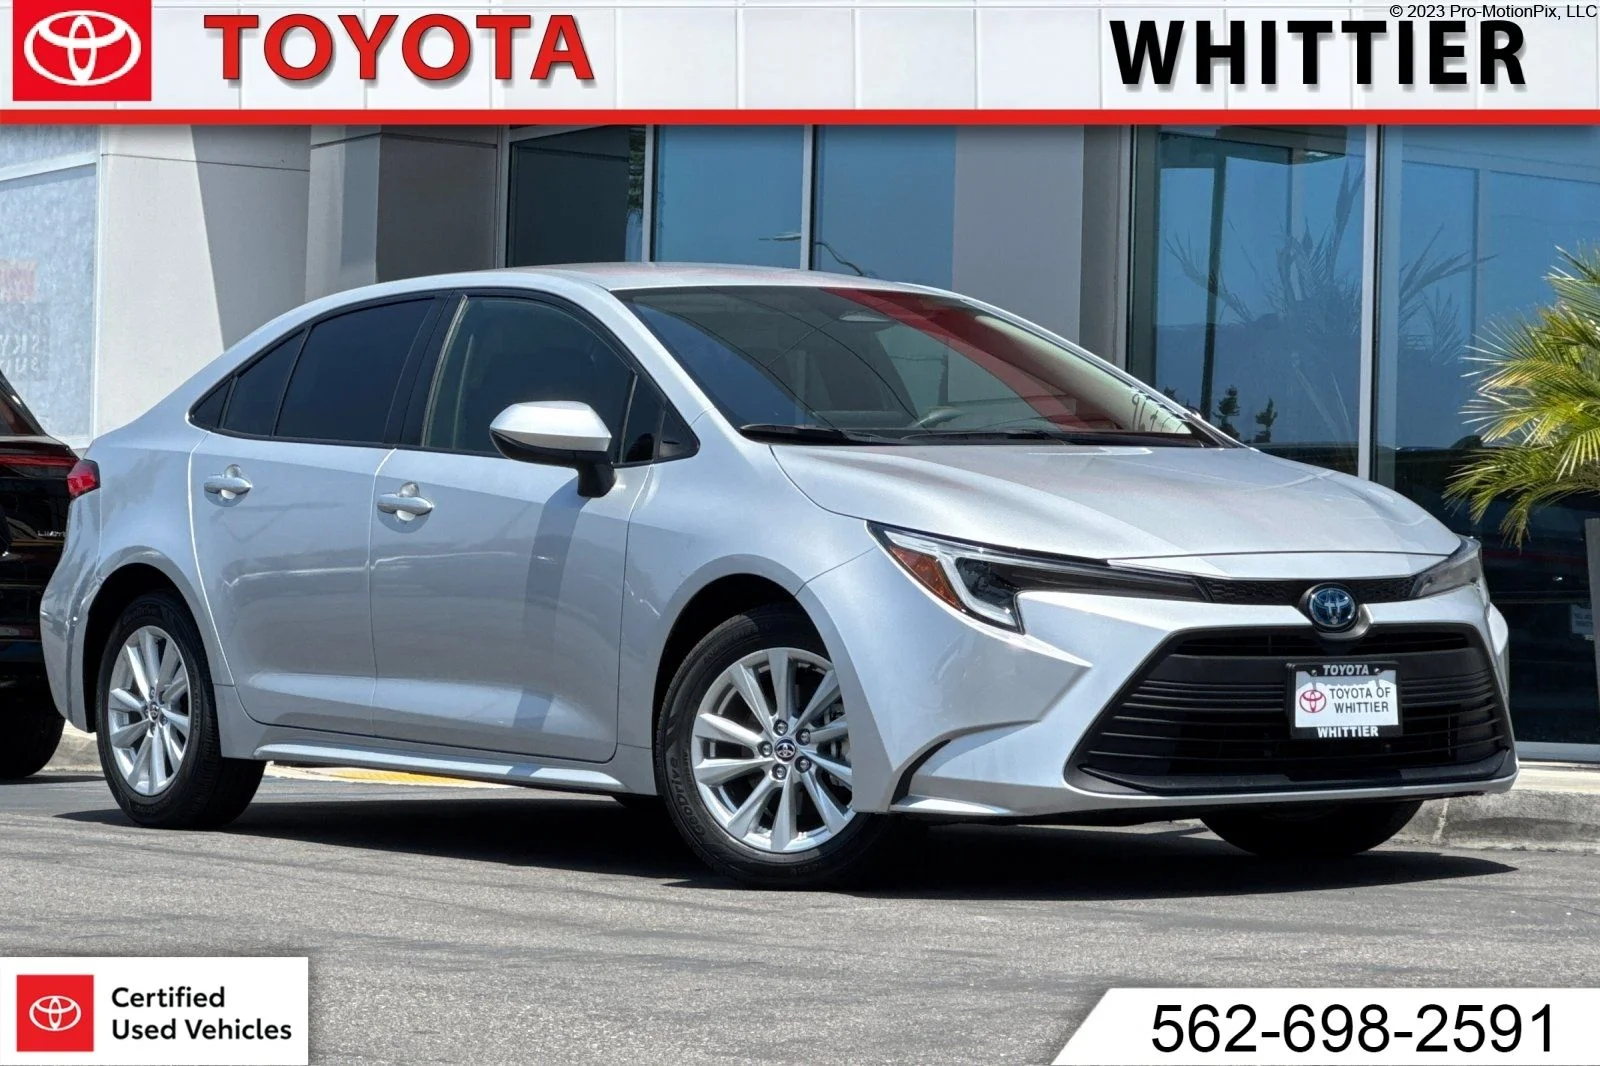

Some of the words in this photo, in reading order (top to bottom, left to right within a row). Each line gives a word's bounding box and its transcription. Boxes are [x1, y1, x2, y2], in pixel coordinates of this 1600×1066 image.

[1322, 664, 1370, 676] TOYOTA
[1329, 687, 1373, 700] TOYOTA
[1376, 687, 1391, 698] OF
[1333, 702, 1389, 714] WHITTIER
[1317, 725, 1379, 739] WHITTIER
